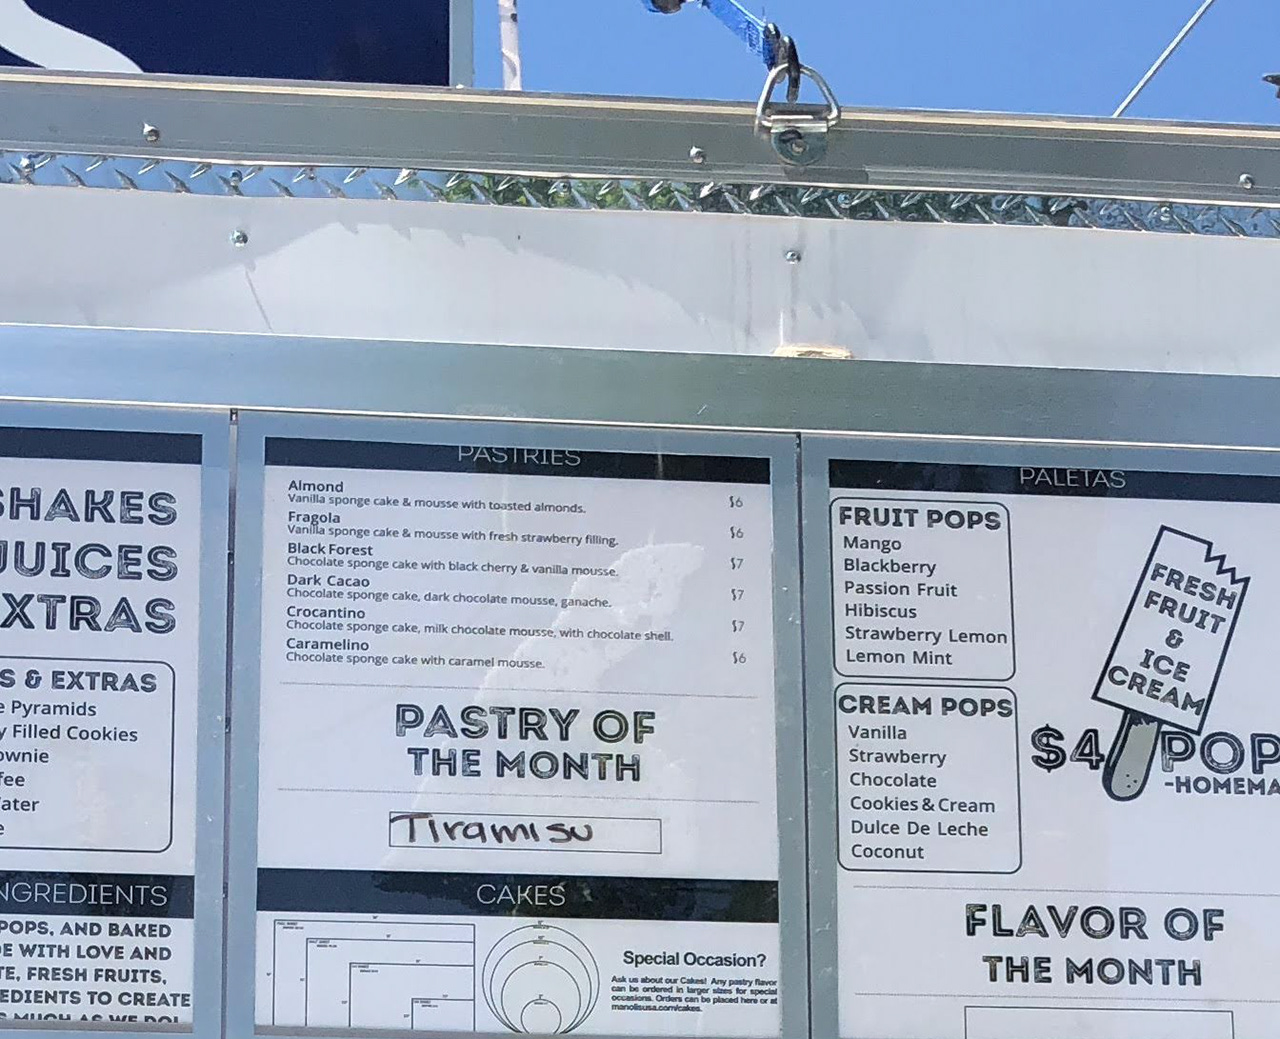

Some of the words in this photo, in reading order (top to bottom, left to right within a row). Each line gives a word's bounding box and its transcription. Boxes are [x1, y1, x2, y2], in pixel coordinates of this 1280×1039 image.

[458, 445, 581, 466] PASTRIES
[288, 479, 343, 492] Almond
[1020, 466, 1125, 488] PALETAS
[287, 493, 325, 503] Vanilla
[328, 496, 370, 507] sponge
[373, 495, 399, 506] cake
[402, 497, 411, 506] &
[414, 499, 458, 508] mousse
[461, 499, 485, 509] with
[488, 501, 531, 511] toasted
[534, 502, 585, 513] almonds.
[288, 510, 340, 528] Fragola
[839, 506, 918, 527] FRUIT
[926, 509, 1000, 530] POPS
[287, 542, 325, 554] Black
[328, 543, 373, 556] Forest
[843, 535, 901, 553] Mango
[844, 557, 936, 577] Blackberry
[287, 573, 321, 585] Dark
[326, 575, 369, 587] Cacao
[1150, 563, 1238, 609] FRESH
[845, 602, 916, 618] Hibiscus
[1143, 590, 1226, 634] FRUIT
[286, 637, 369, 650] Caramelino
[845, 625, 941, 645] Strawberry
[948, 629, 1007, 643] Lemon
[1140, 648, 1191, 682] ICE
[24, 669, 42, 688] &
[51, 670, 156, 692] EXTRAS
[1108, 664, 1206, 716] CREAM
[11, 699, 96, 718] Pyramids
[838, 694, 931, 715] CREAM
[941, 696, 1013, 717] POPS
[12, 723, 60, 739] Filled
[66, 725, 137, 741] Cookies
[395, 703, 579, 741] PASTRY
[592, 709, 655, 743] OF
[1030, 723, 1105, 773] $4
[407, 747, 481, 776] THE
[496, 750, 640, 781] MONTH
[851, 819, 899, 834] Dulce
[907, 821, 930, 835] De
[937, 821, 988, 836] Leche
[476, 882, 565, 906] CAKES
[59, 921, 102, 936] AND
[108, 922, 171, 937] BAKED
[623, 950, 679, 967] Special
[683, 951, 766, 967] Occasion?
